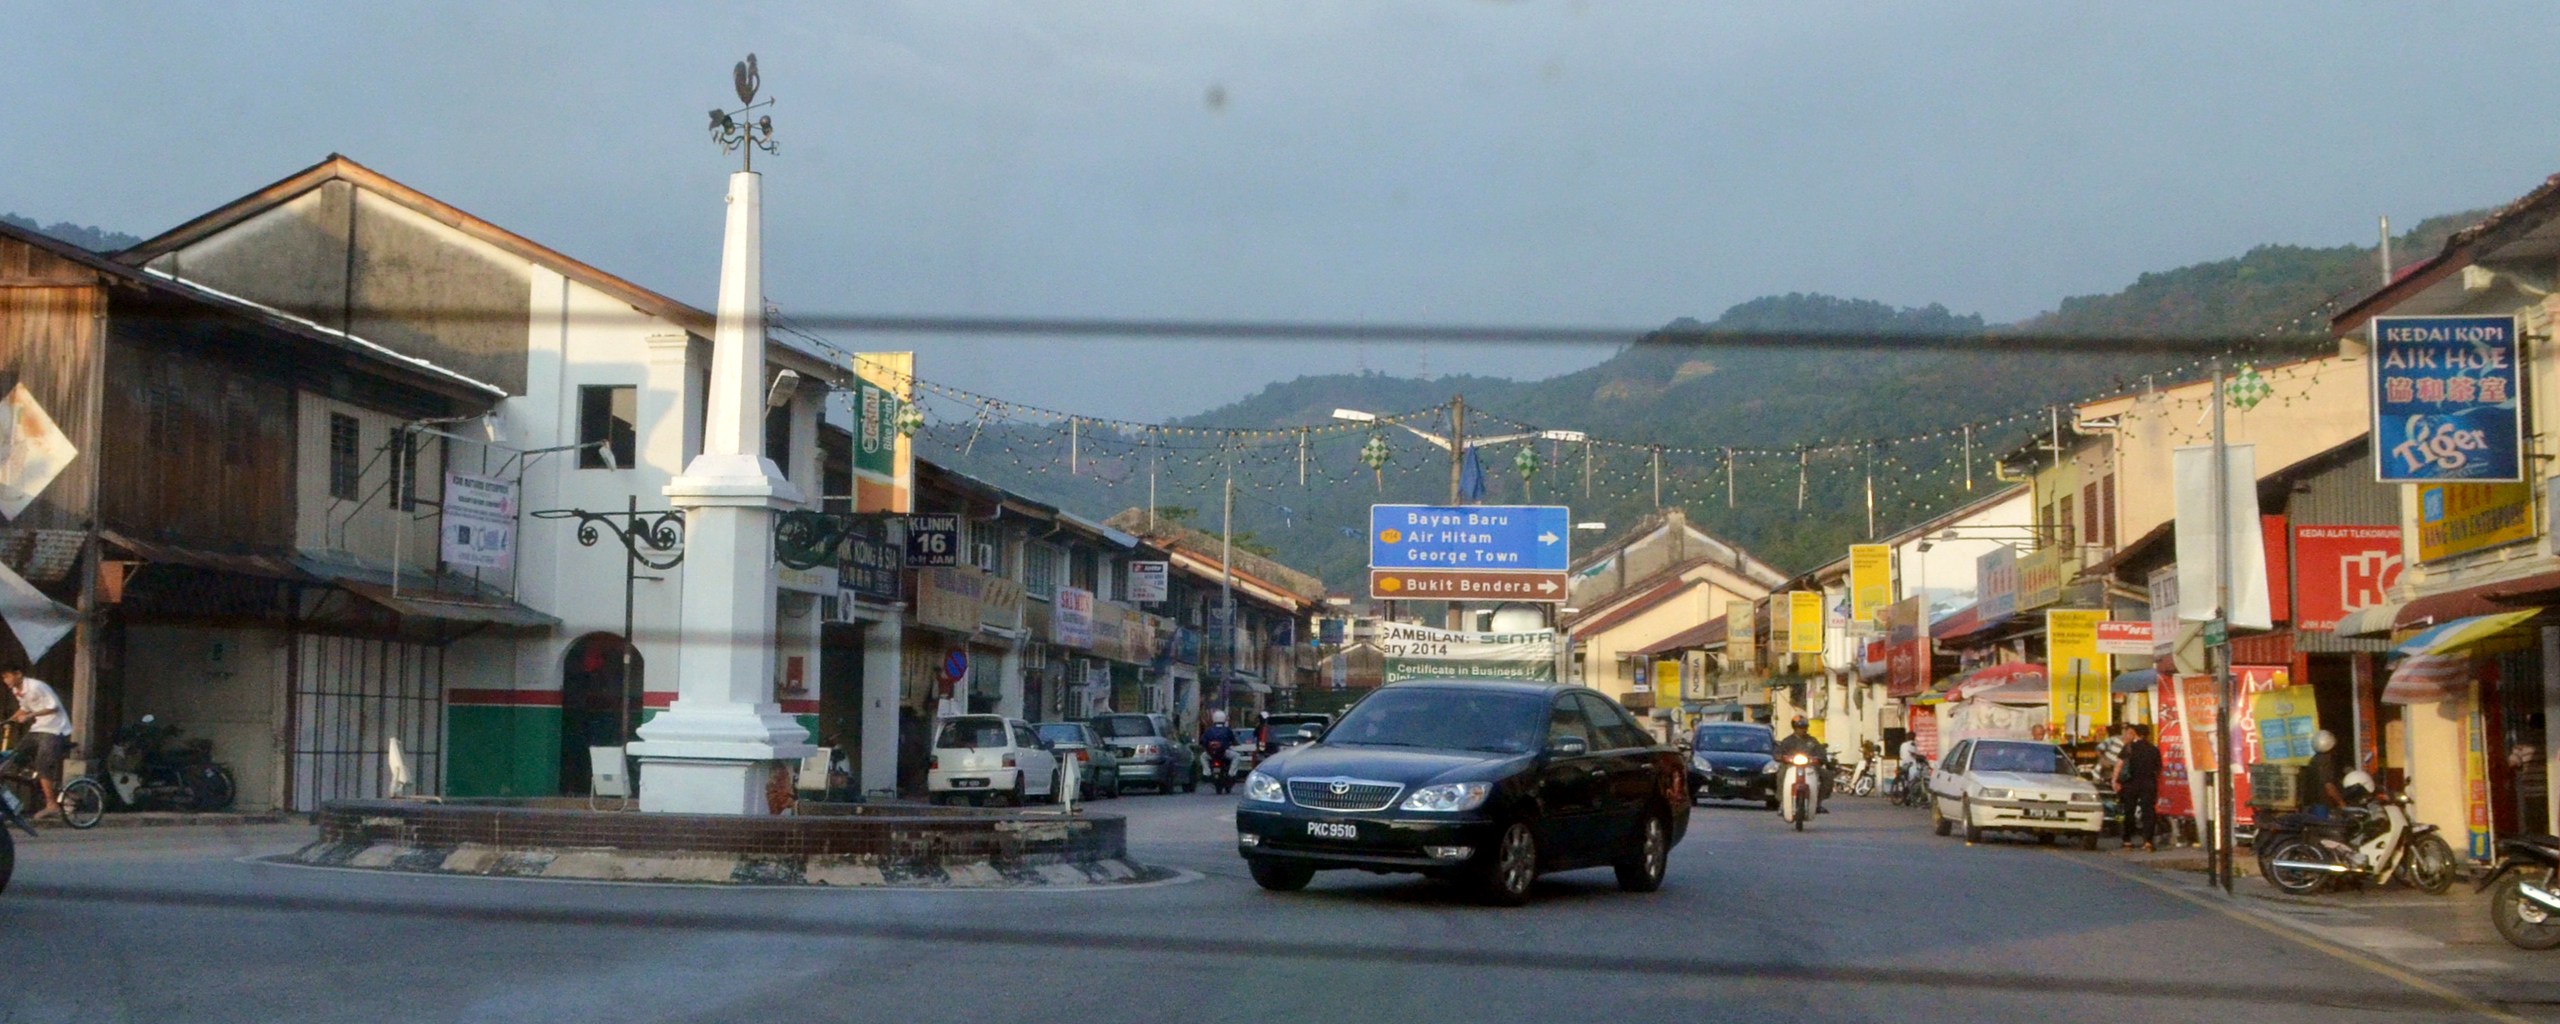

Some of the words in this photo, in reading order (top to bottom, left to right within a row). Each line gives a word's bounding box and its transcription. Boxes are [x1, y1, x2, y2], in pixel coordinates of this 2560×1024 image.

[2387, 327, 2449, 342] KEDAI
[2455, 327, 2503, 341] KOPI
[2384, 348, 2436, 369] AIK
[2445, 347, 2508, 369] HOE
[883, 425, 892, 451] Bike
[2392, 416, 2488, 473] Tiger
[909, 517, 955, 531] KLINIK
[1408, 513, 1461, 527] Bayan
[1469, 513, 1507, 525] Baru
[1408, 531, 1434, 543] Air
[1442, 531, 1491, 543] Hitam
[2300, 529, 2326, 537] KEDAI
[2327, 529, 2348, 537] ALAT
[917, 533, 946, 553] 16
[930, 555, 954, 564] JAM
[1408, 549, 1467, 564] George
[1475, 549, 1518, 562] Town
[1407, 579, 1453, 591] Bukit
[1461, 580, 1531, 592] Bendera
[1411, 643, 1447, 655] 2014
[1397, 664, 1455, 675] Certificate
[1458, 667, 1468, 675] in
[1472, 667, 1523, 676] Business
[1692, 658, 1700, 692] NOKIA
[1307, 822, 1329, 836] PKC
[1329, 824, 1357, 838] 9510
